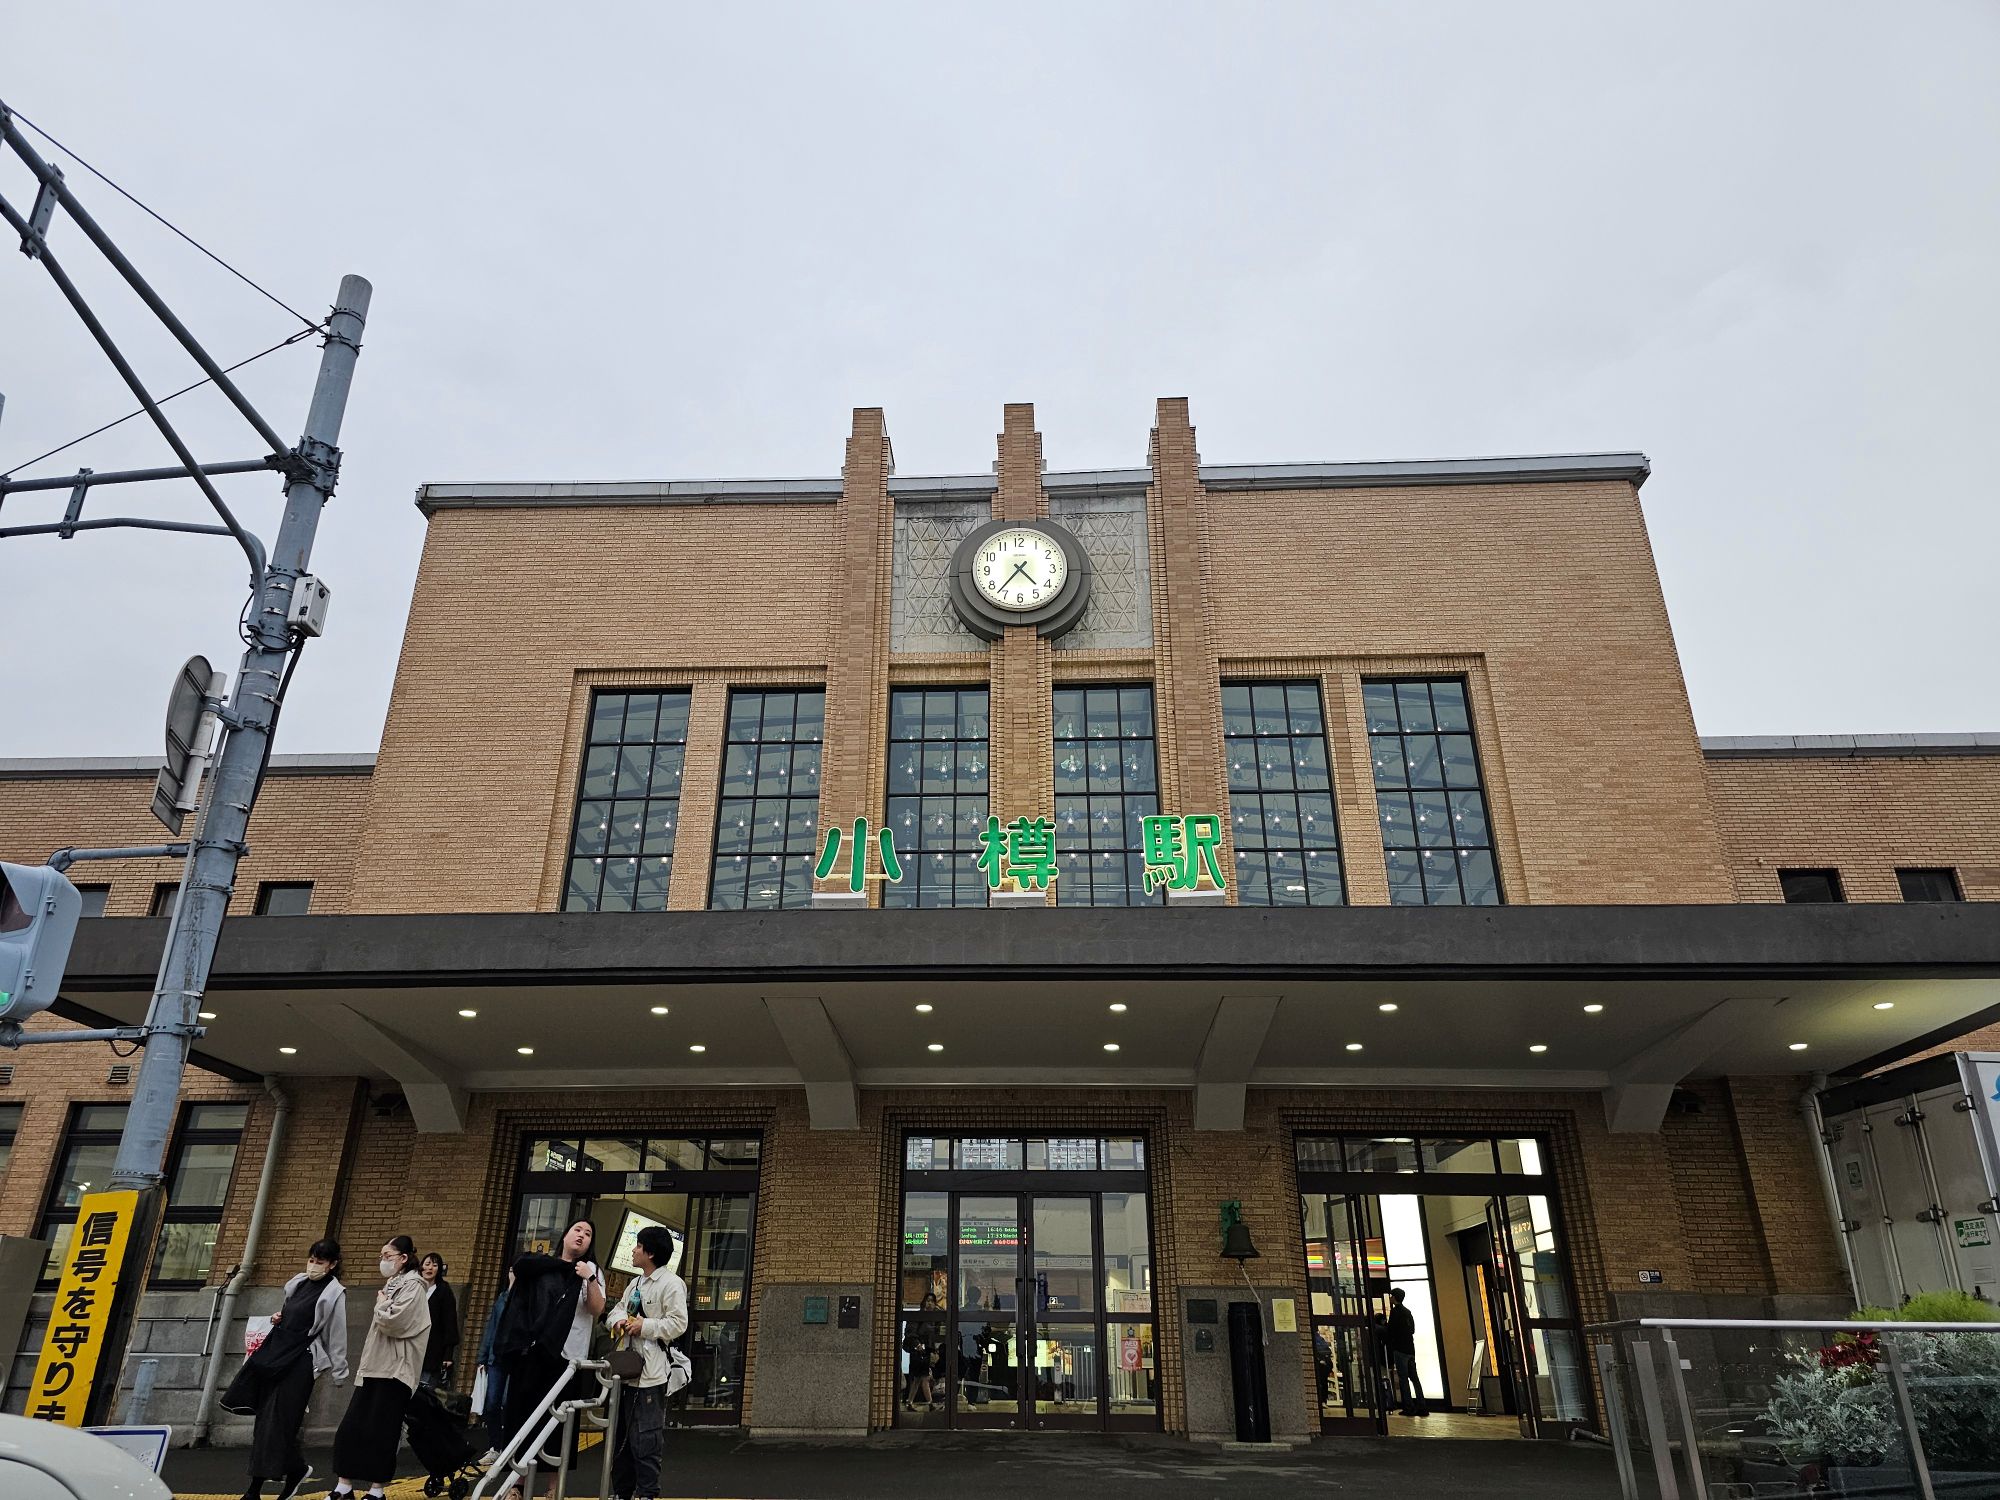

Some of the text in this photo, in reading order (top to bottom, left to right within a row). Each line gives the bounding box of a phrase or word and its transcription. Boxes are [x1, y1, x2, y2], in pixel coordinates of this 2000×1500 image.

[999, 541, 1007, 551] 11
[1014, 537, 1025, 548] 12
[986, 552, 996, 562] 10
[1044, 549, 1052, 560] 2
[983, 565, 991, 576] 9
[1048, 563, 1057, 574] 3
[988, 580, 996, 590] 8
[1043, 578, 1052, 589] 4
[1001, 589, 1009, 600] 7
[1016, 592, 1024, 603] 6
[1032, 588, 1040, 599] 5
[815, 815, 1227, 895] 小樽駅
